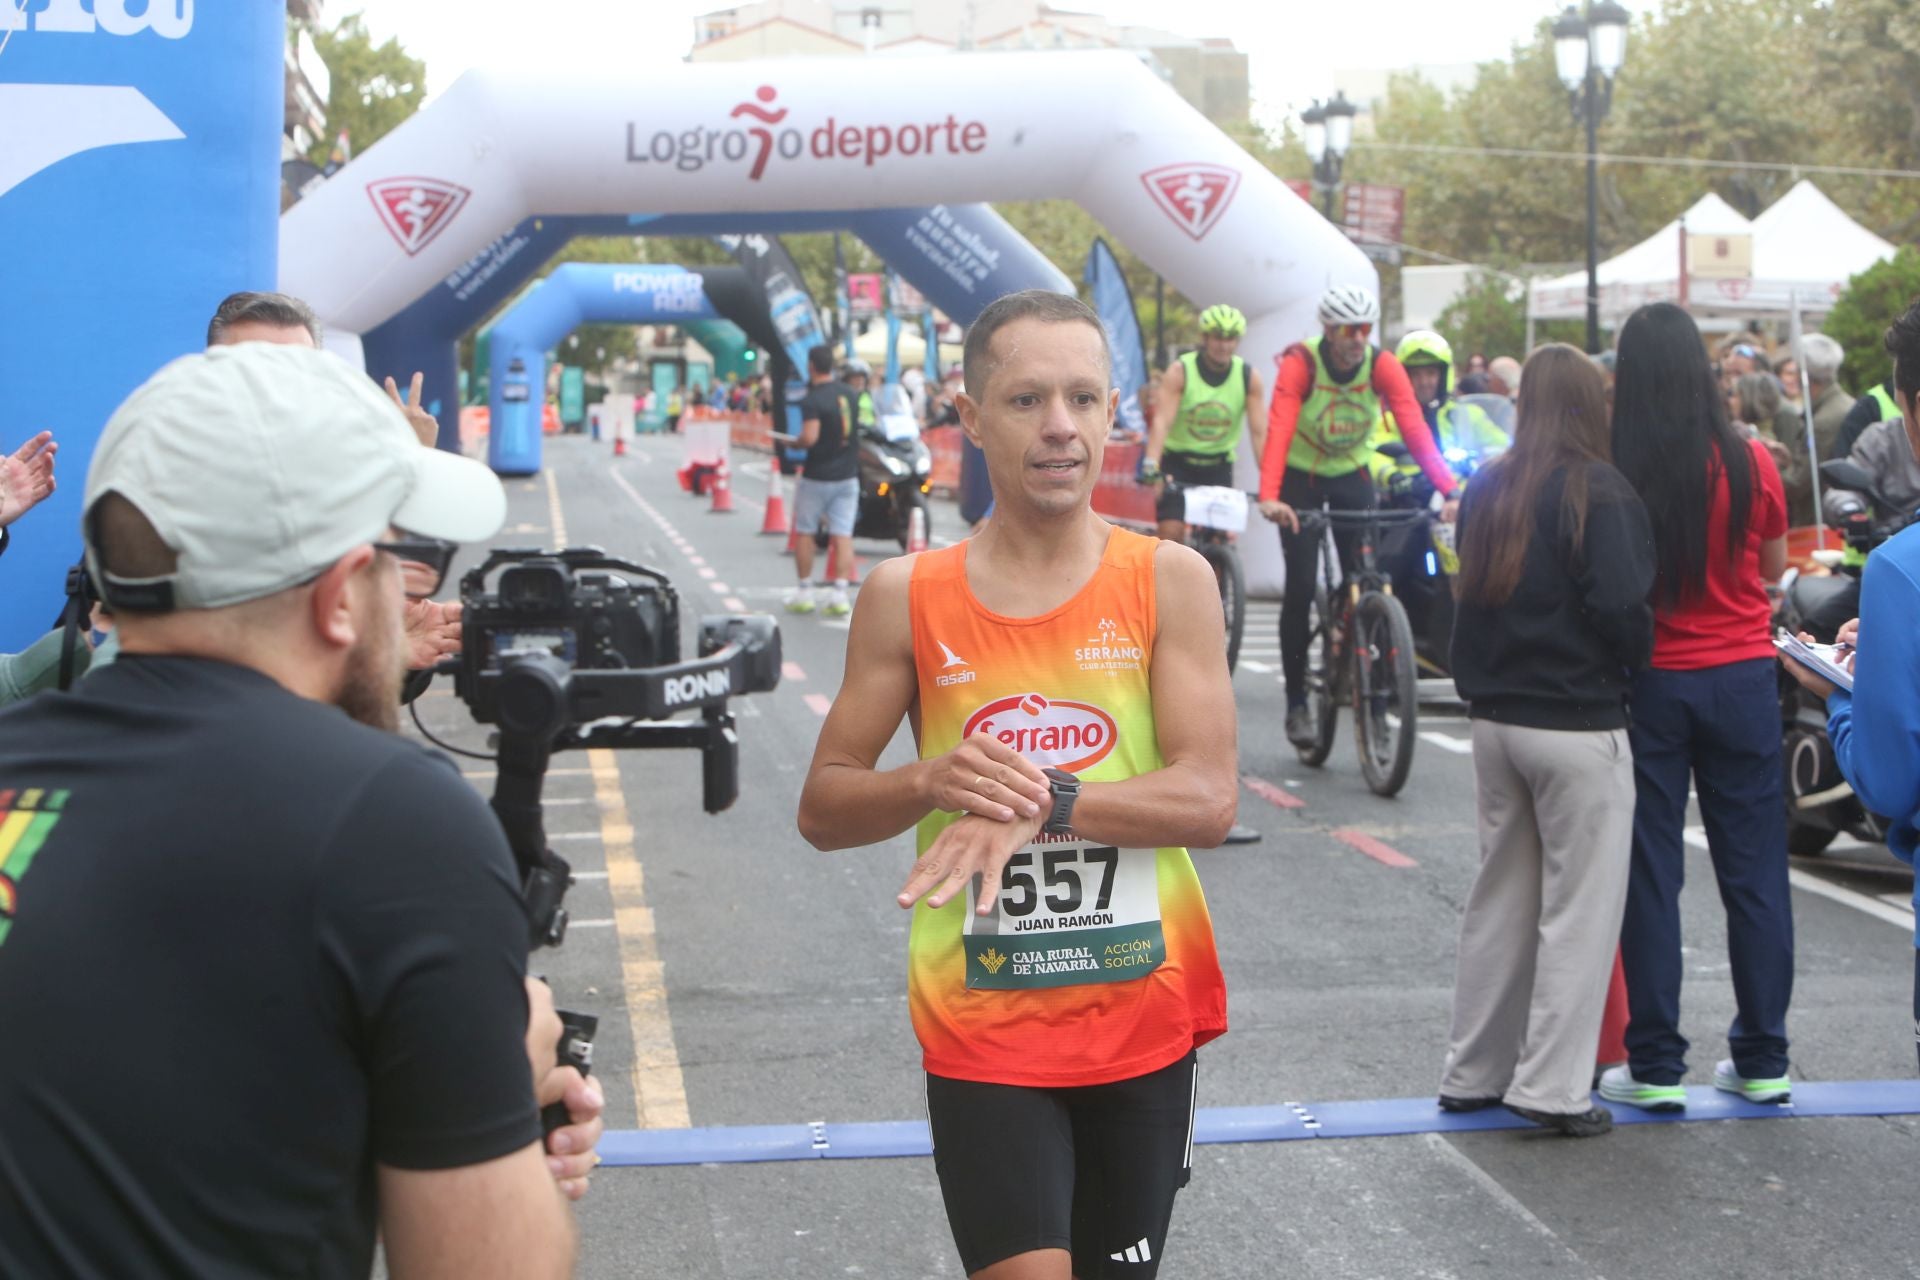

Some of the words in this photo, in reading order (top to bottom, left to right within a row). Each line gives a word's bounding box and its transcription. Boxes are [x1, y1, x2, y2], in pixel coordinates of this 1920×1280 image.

[810, 114, 987, 166] deporte
[613, 272, 704, 294] POWER
[1074, 646, 1143, 661] SERRANO
[663, 668, 731, 706] RONIN
[936, 670, 976, 687] rasán
[1001, 846, 1119, 917] 557
[1014, 917, 1055, 932] JUAN
[1058, 911, 1114, 930] RAMÓN
[1104, 938, 1152, 955] ACCIÓN
[1013, 951, 1044, 965] CAJA
[1046, 947, 1093, 962] RURAL
[1104, 953, 1153, 969] SOCIAL
[1013, 964, 1033, 975] DE
[1034, 959, 1100, 975] NAVARRA
